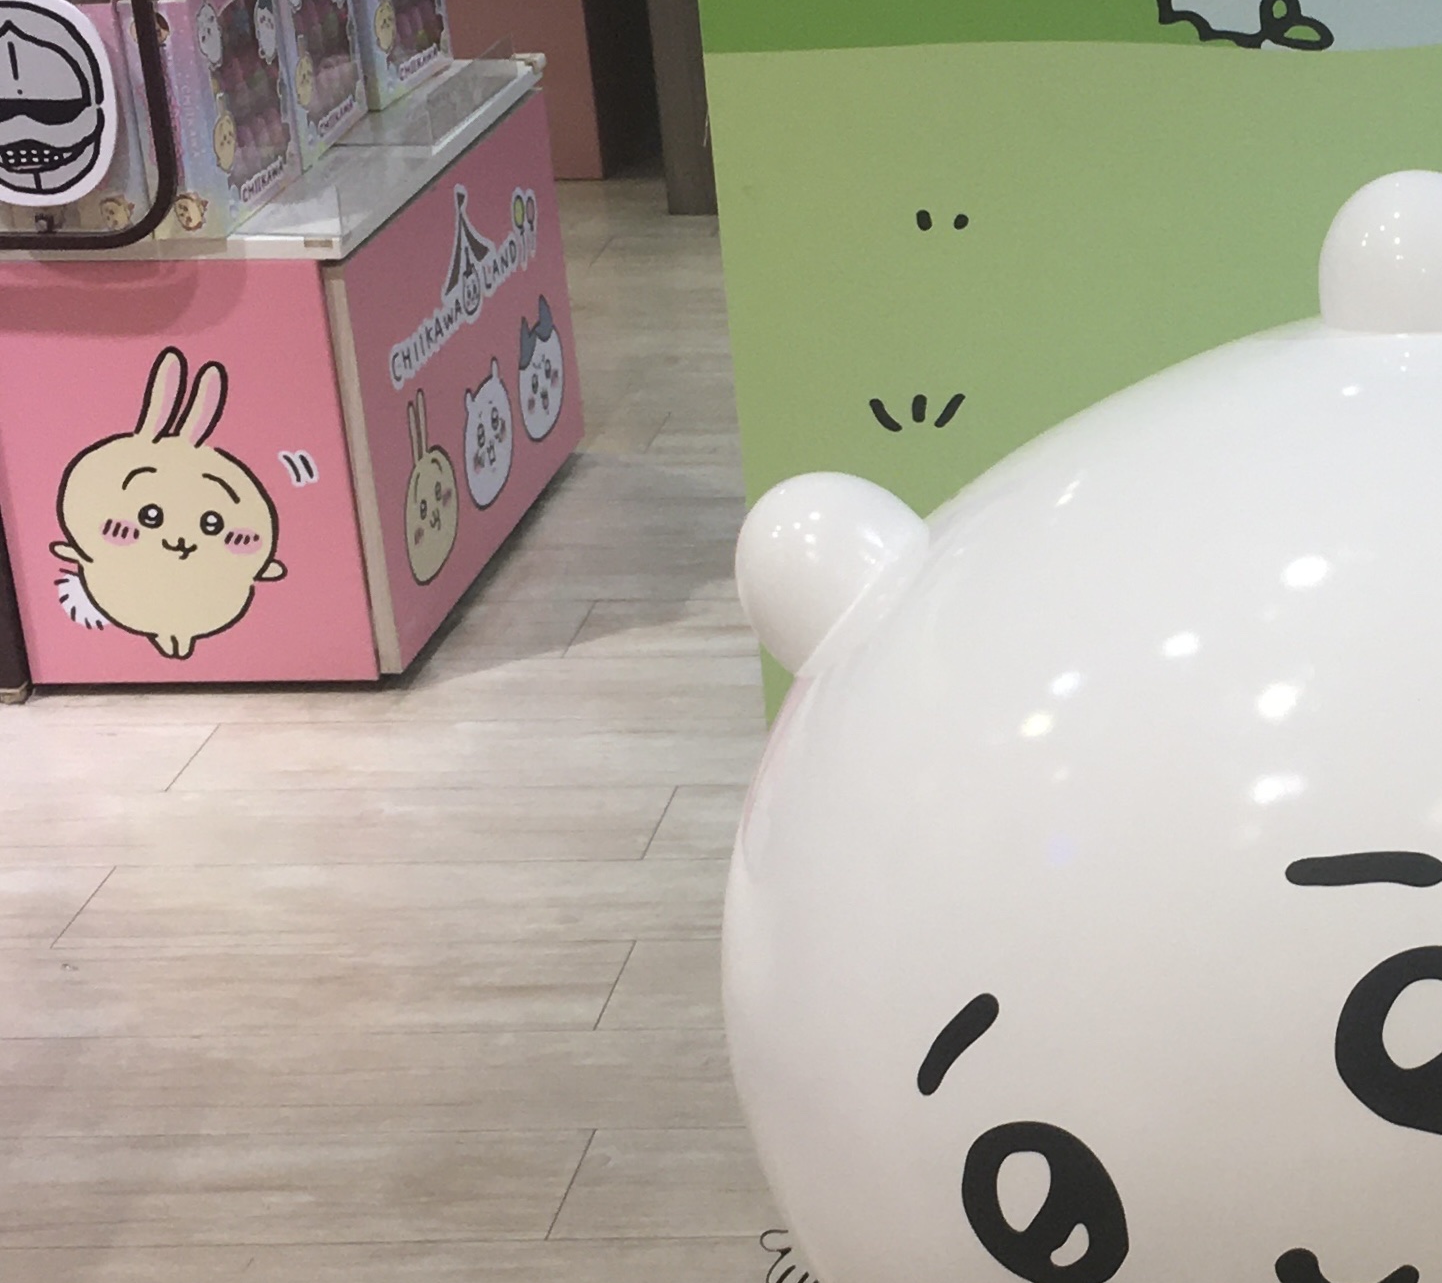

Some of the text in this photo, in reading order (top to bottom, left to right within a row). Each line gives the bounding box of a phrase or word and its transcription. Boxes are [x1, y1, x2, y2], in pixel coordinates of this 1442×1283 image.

[242, 162, 284, 203] CHIIKAWA
[390, 239, 517, 382] CHIIKAWA LAND
